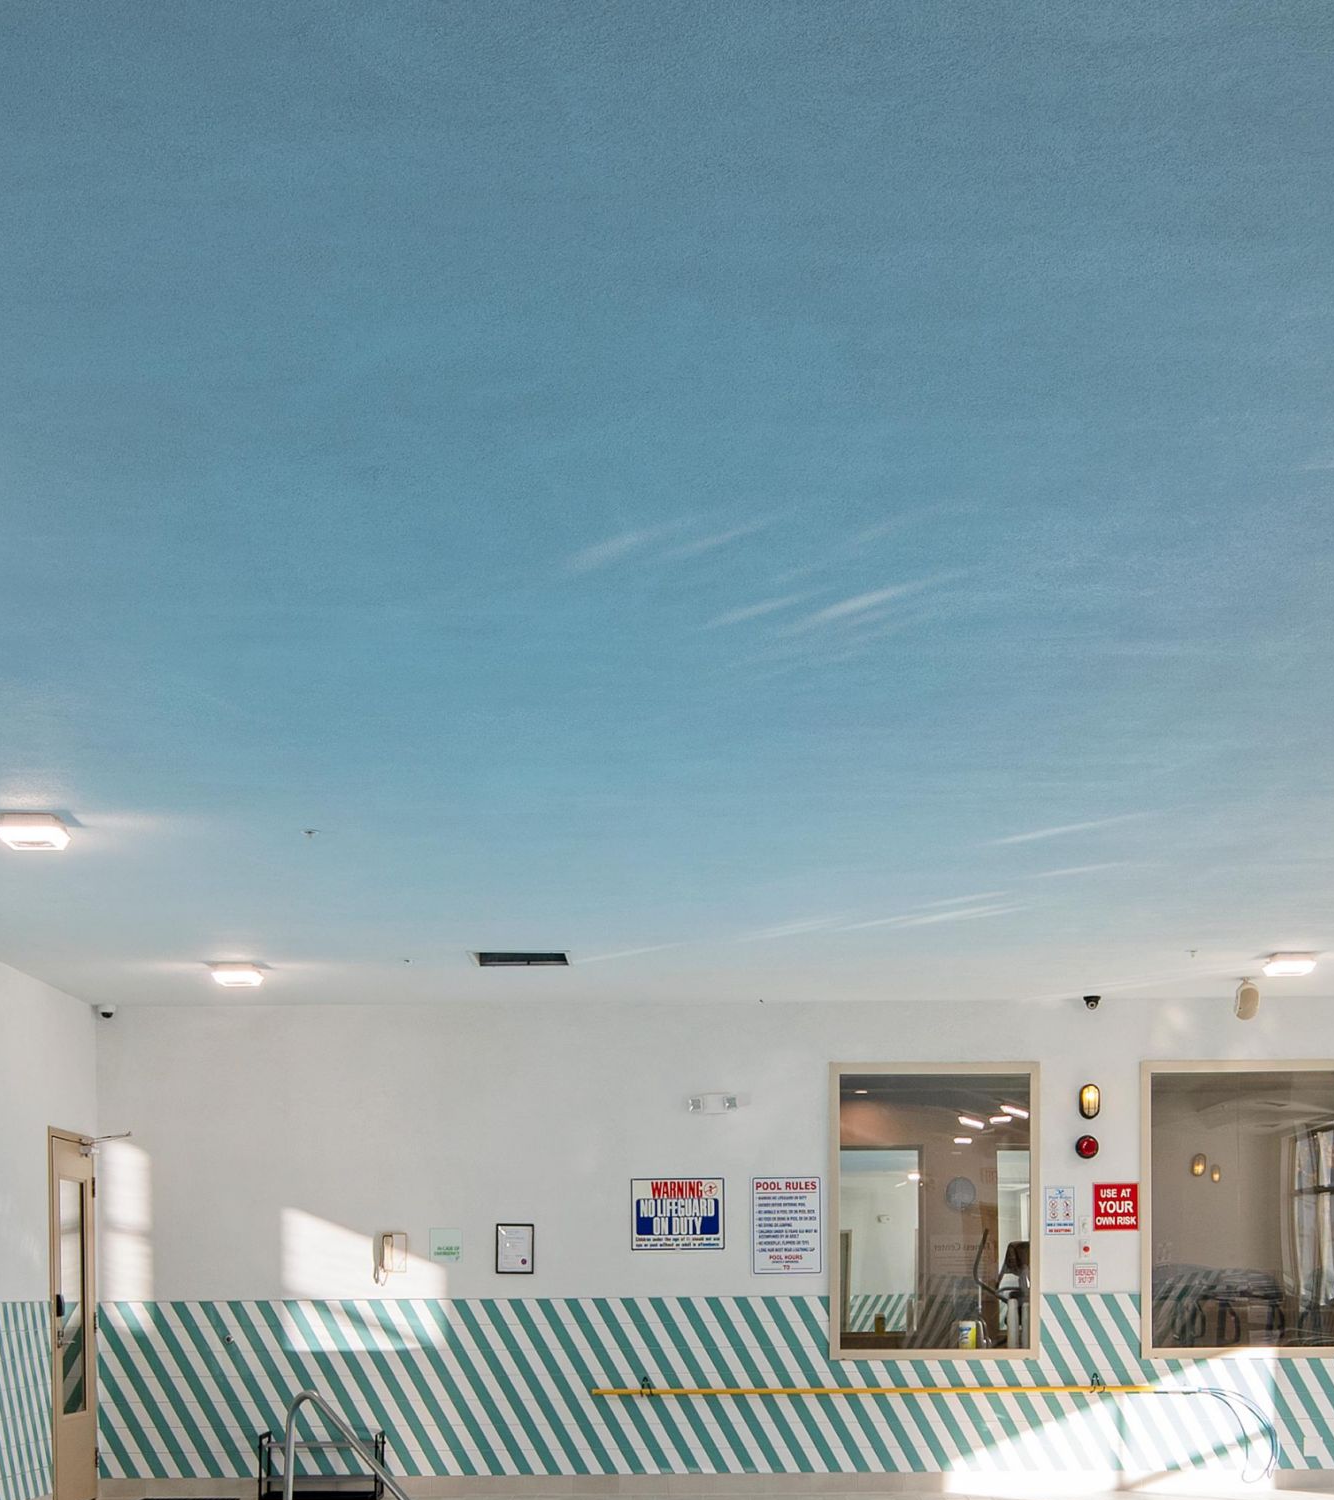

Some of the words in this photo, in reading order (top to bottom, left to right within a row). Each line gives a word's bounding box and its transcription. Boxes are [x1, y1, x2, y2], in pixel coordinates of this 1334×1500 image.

[650, 1181, 703, 1199] WARNING
[756, 1182, 782, 1190] POOL
[785, 1181, 817, 1190] RULES
[1100, 1189, 1118, 1198] USE
[1120, 1189, 1132, 1198] AT
[640, 1199, 656, 1217] NO
[657, 1199, 715, 1217] LIFEGUARD
[1098, 1201, 1134, 1213] YOUR
[653, 1217, 669, 1235] ON
[672, 1217, 702, 1235] DUTY
[1095, 1217, 1116, 1226] OWN
[1118, 1216, 1137, 1225] RISK
